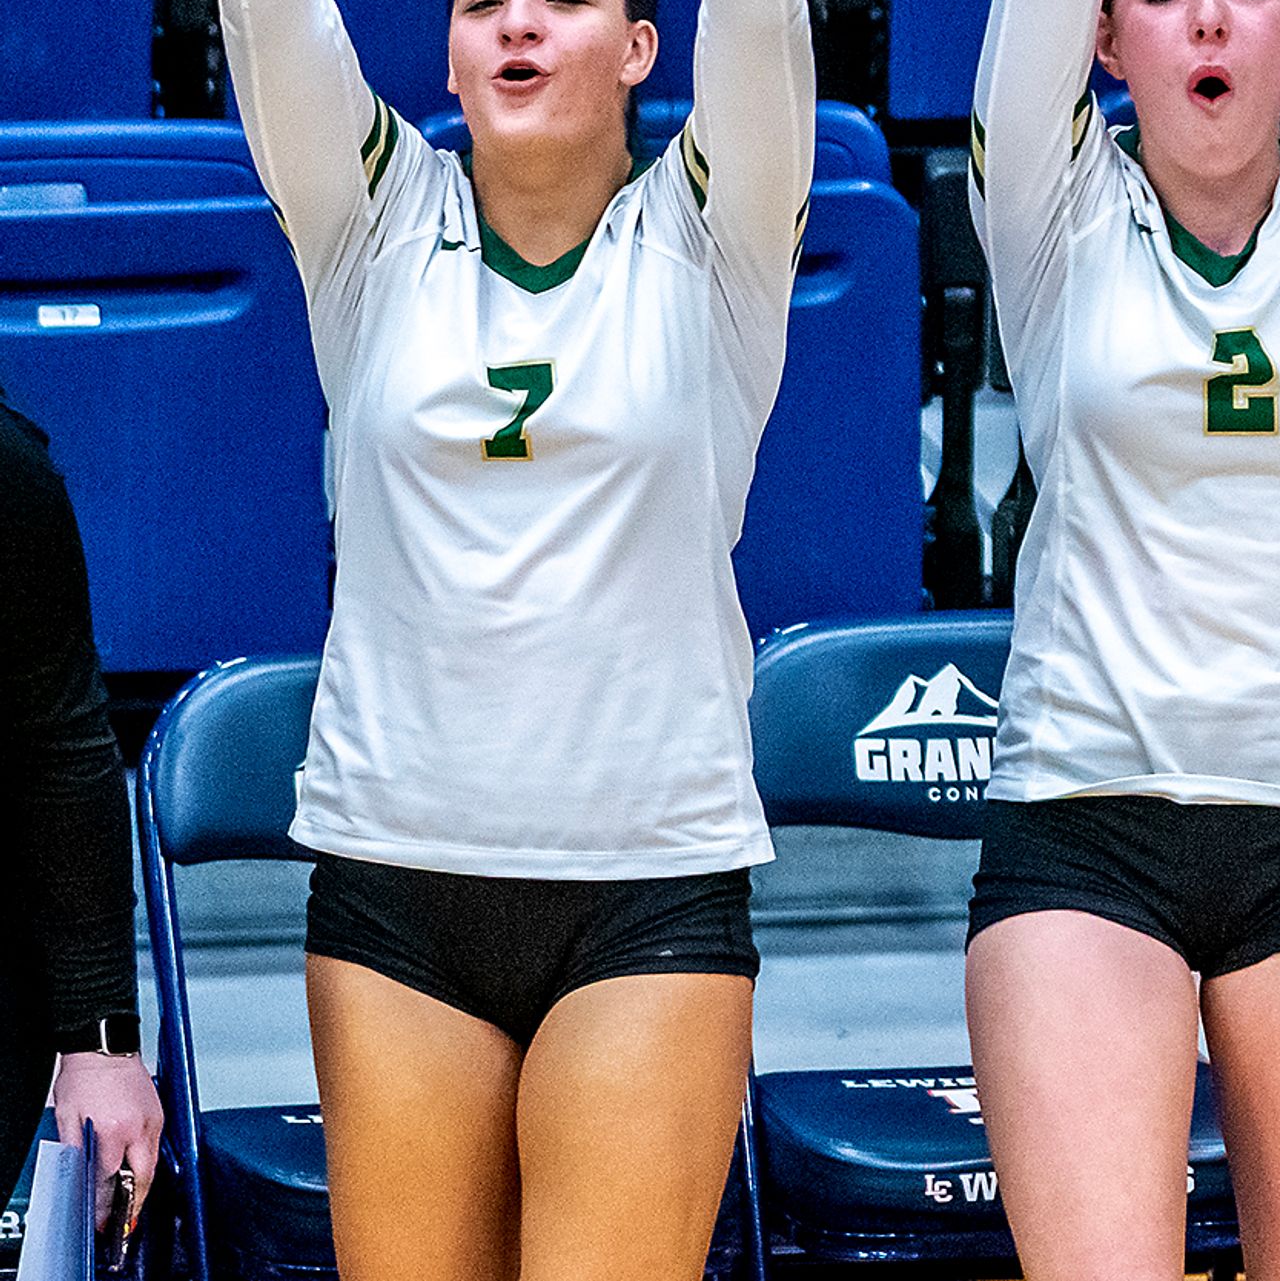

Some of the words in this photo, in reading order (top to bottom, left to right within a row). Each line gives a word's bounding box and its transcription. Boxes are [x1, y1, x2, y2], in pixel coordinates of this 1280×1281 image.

[480, 359, 556, 461] 7
[1202, 326, 1280, 437] 2
[854, 736, 997, 782] GRAN
